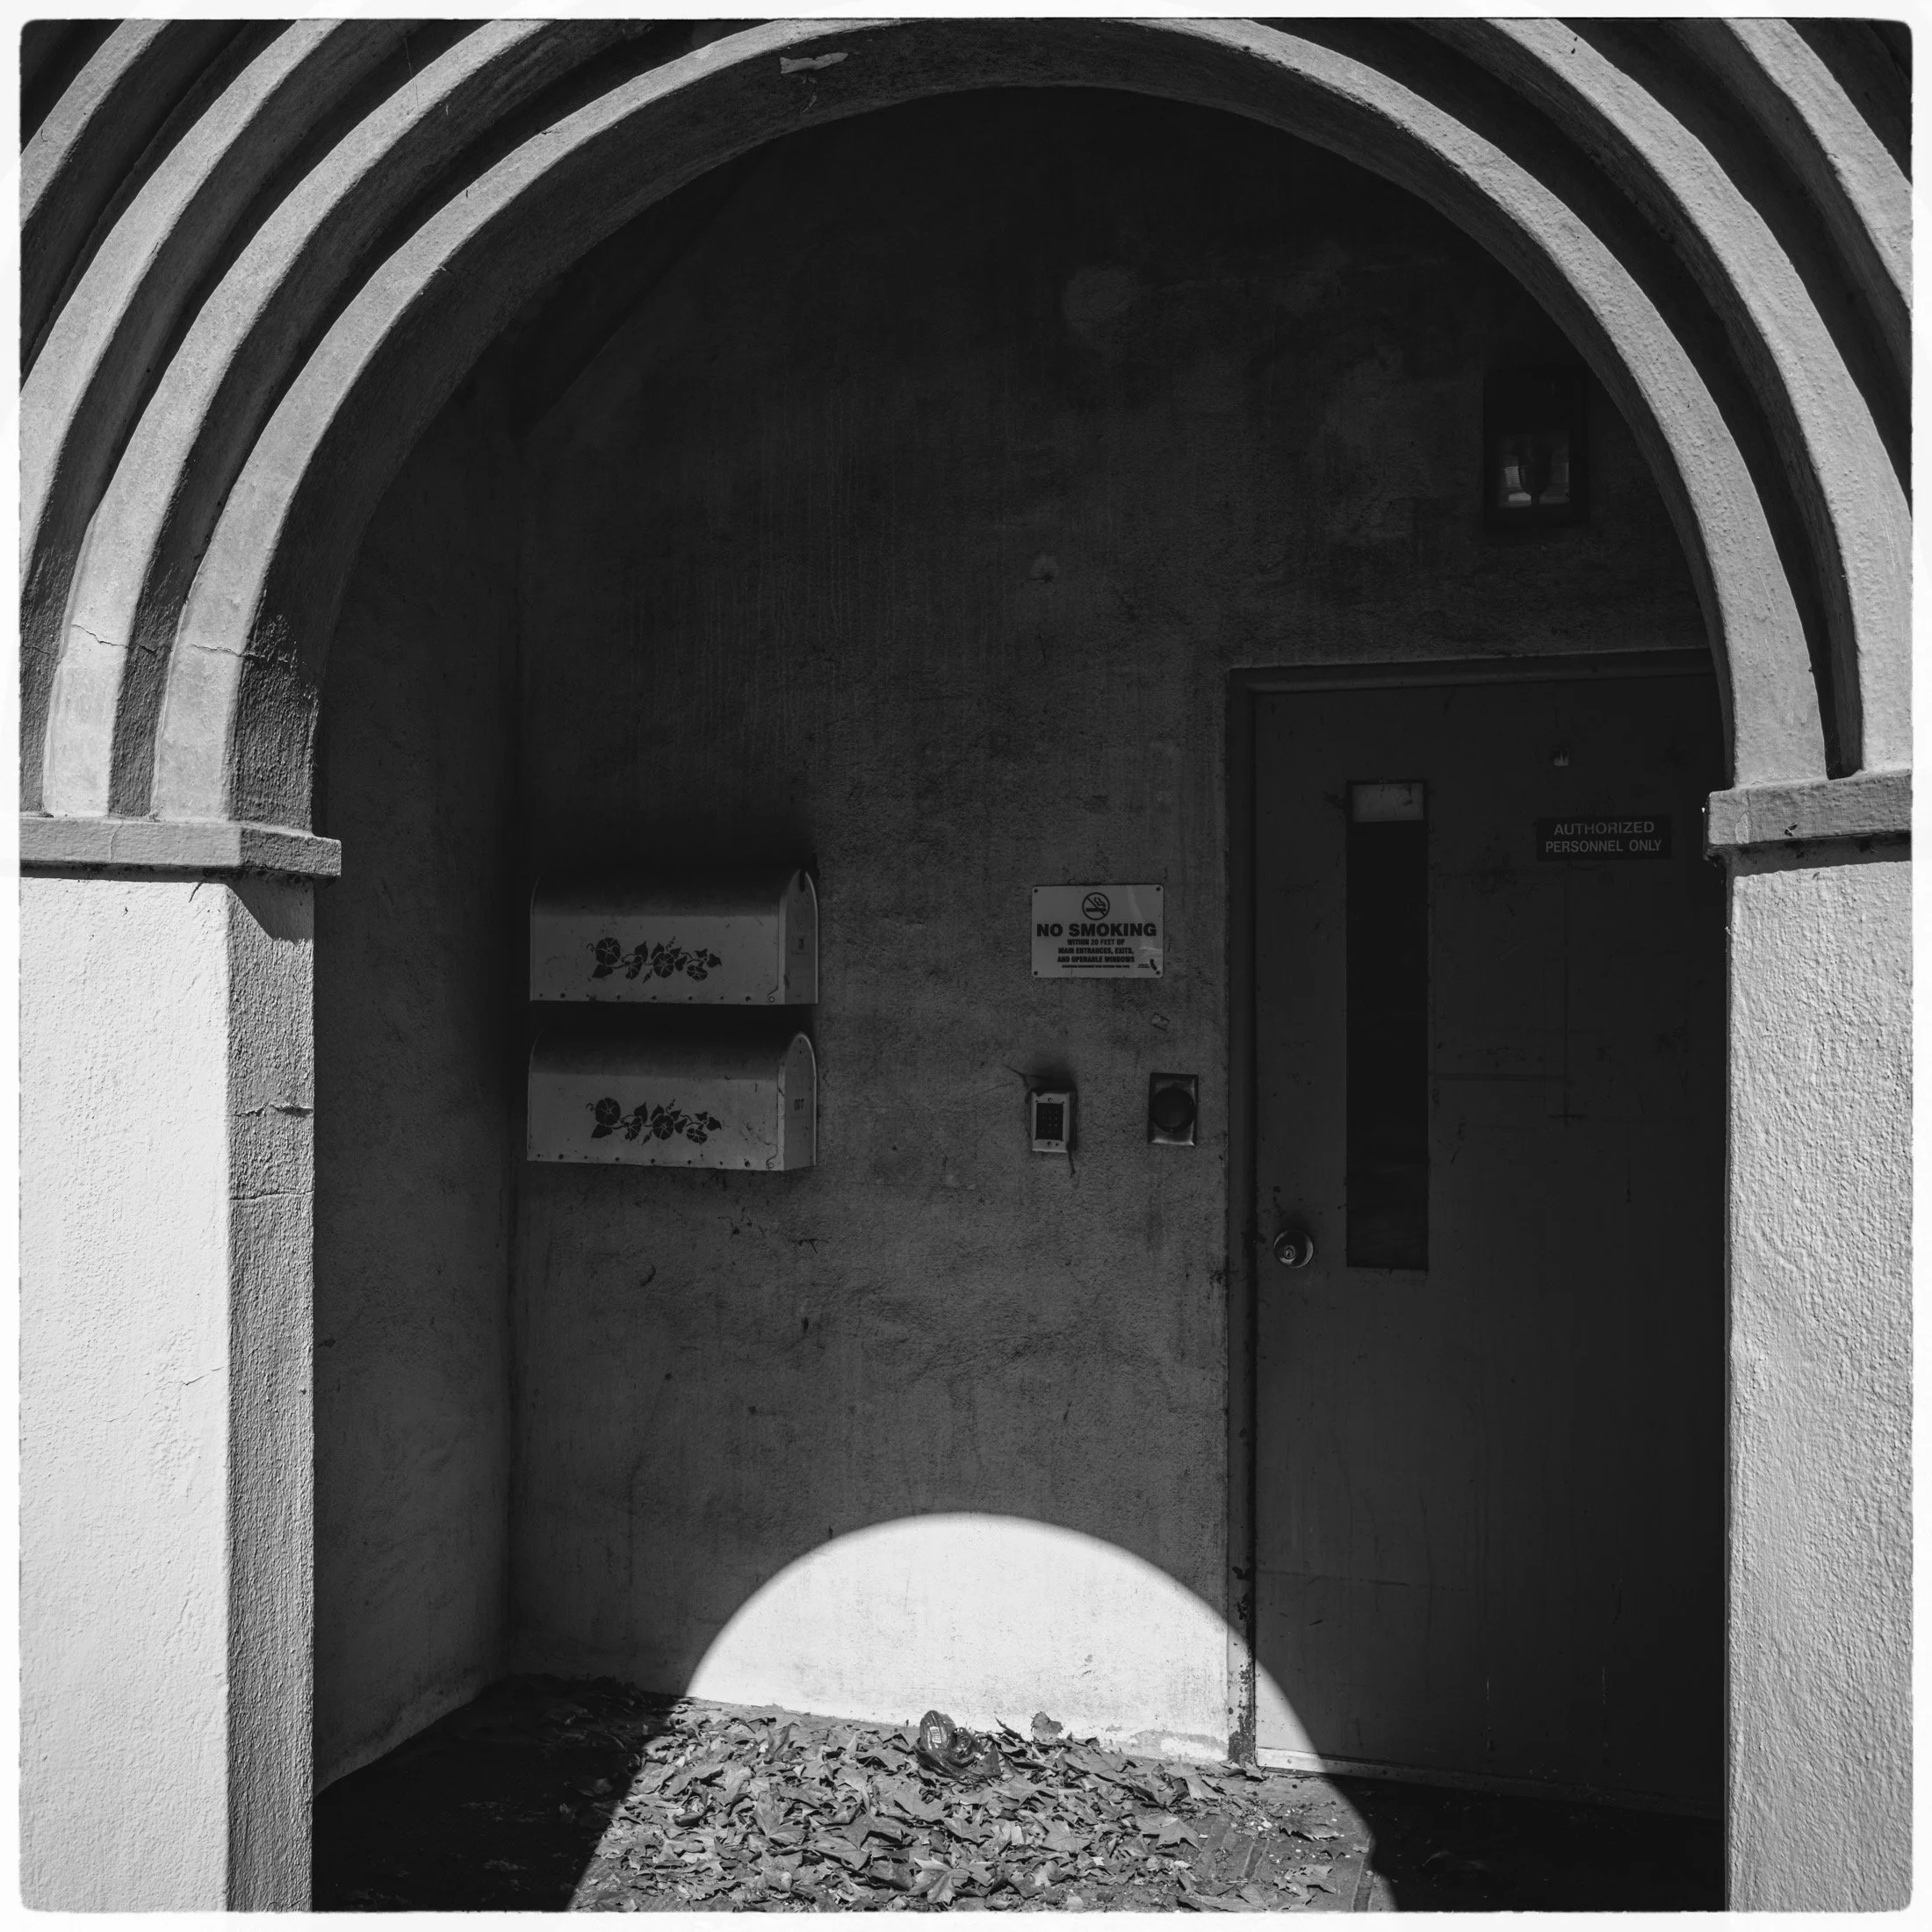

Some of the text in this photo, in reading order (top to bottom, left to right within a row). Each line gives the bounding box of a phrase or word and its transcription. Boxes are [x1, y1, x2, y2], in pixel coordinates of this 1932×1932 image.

[1554, 821, 1655, 835] AUTHORIZED
[1546, 839, 1662, 853] PERSONNEL ONLY
[1036, 923, 1157, 937] NO SMOKING
